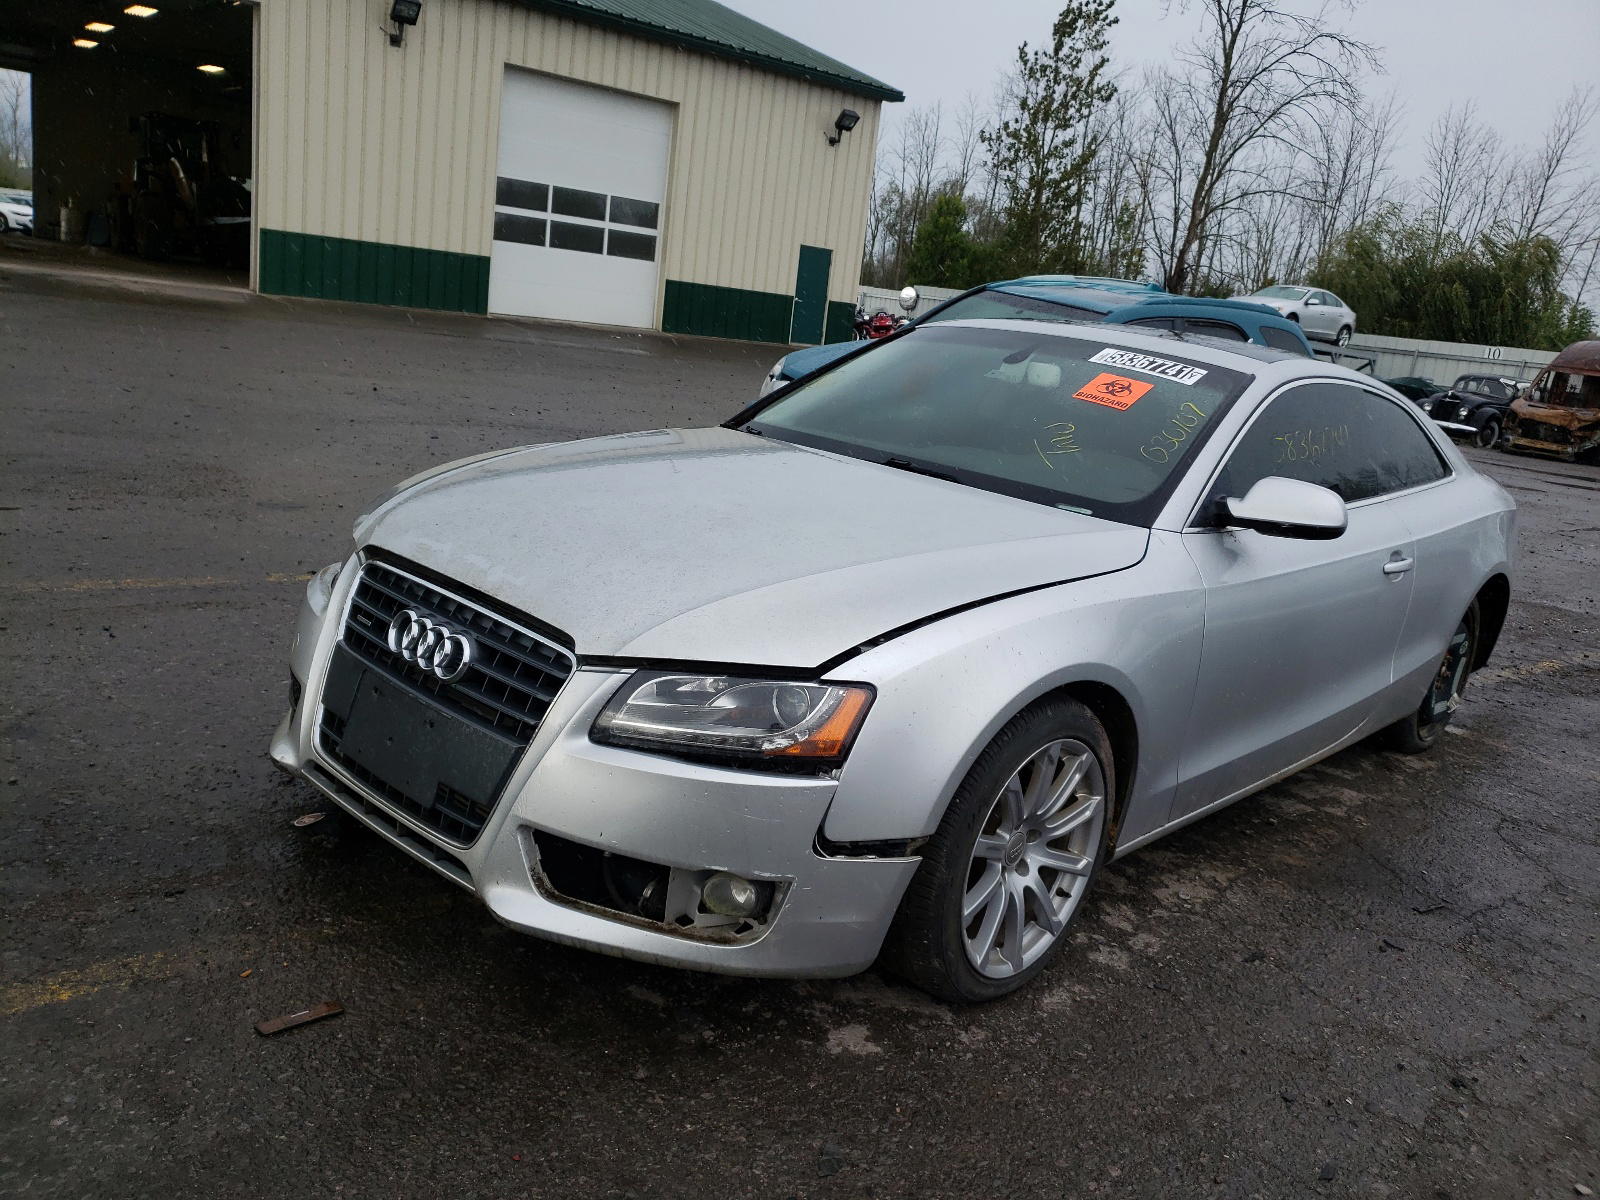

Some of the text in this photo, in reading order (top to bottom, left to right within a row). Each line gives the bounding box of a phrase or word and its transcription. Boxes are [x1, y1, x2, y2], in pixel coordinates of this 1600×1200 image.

[1487, 347, 1501, 360] 10
[1109, 350, 1189, 380] 58367741
[1075, 391, 1129, 409] BIOHAZARD
